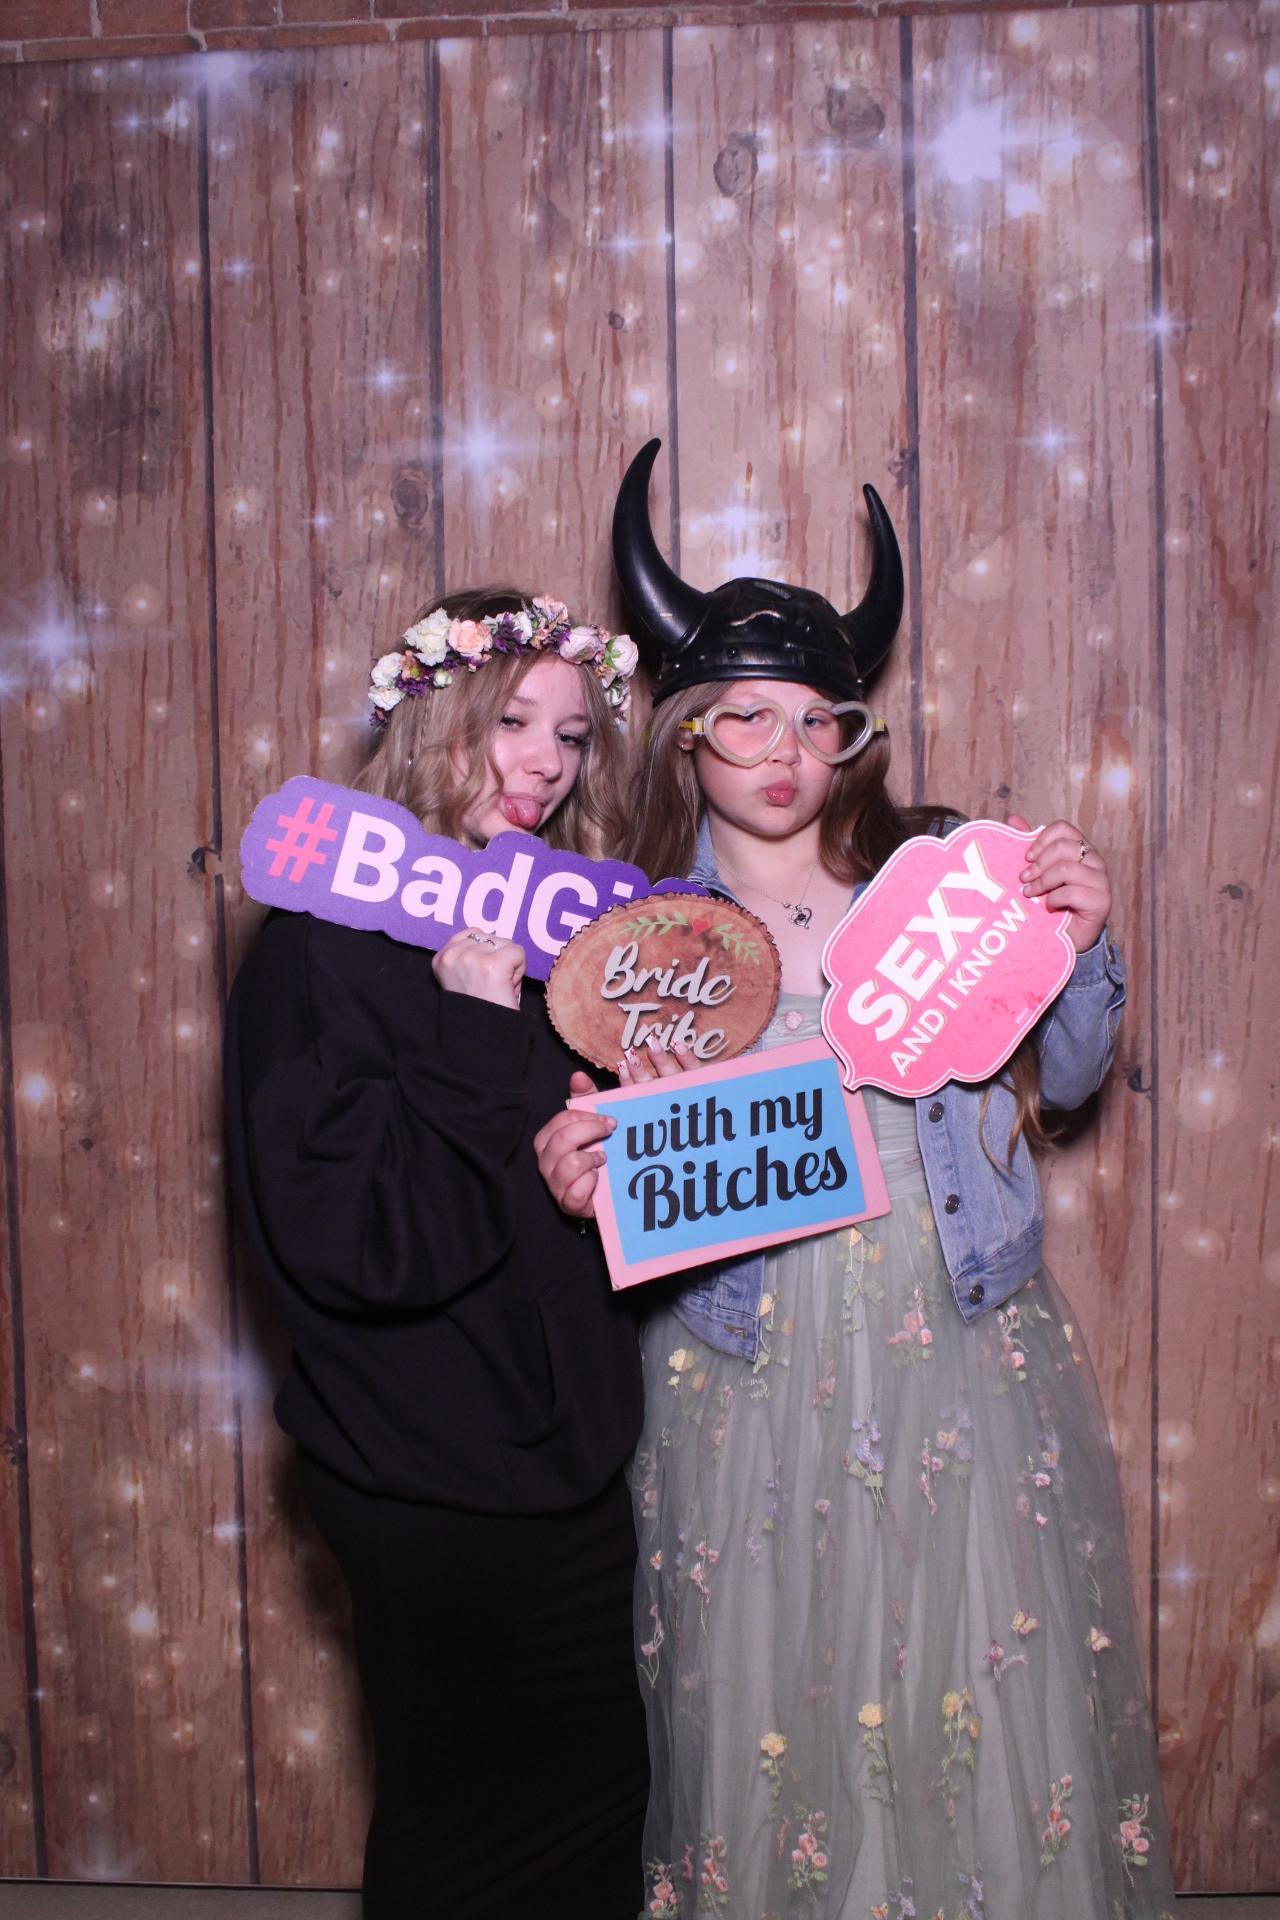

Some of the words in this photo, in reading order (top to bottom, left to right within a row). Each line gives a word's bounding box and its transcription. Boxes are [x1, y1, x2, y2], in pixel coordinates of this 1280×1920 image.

[600, 941, 737, 1006] Bride
[847, 839, 1006, 1042] SEXY
[947, 897, 1028, 997] KNOW
[617, 1002, 730, 1059] Tribe
[937, 991, 960, 1011] I
[890, 1008, 946, 1078] AND
[626, 1096, 737, 1161] with
[750, 1088, 823, 1142] my
[628, 1146, 848, 1232] Bitches
